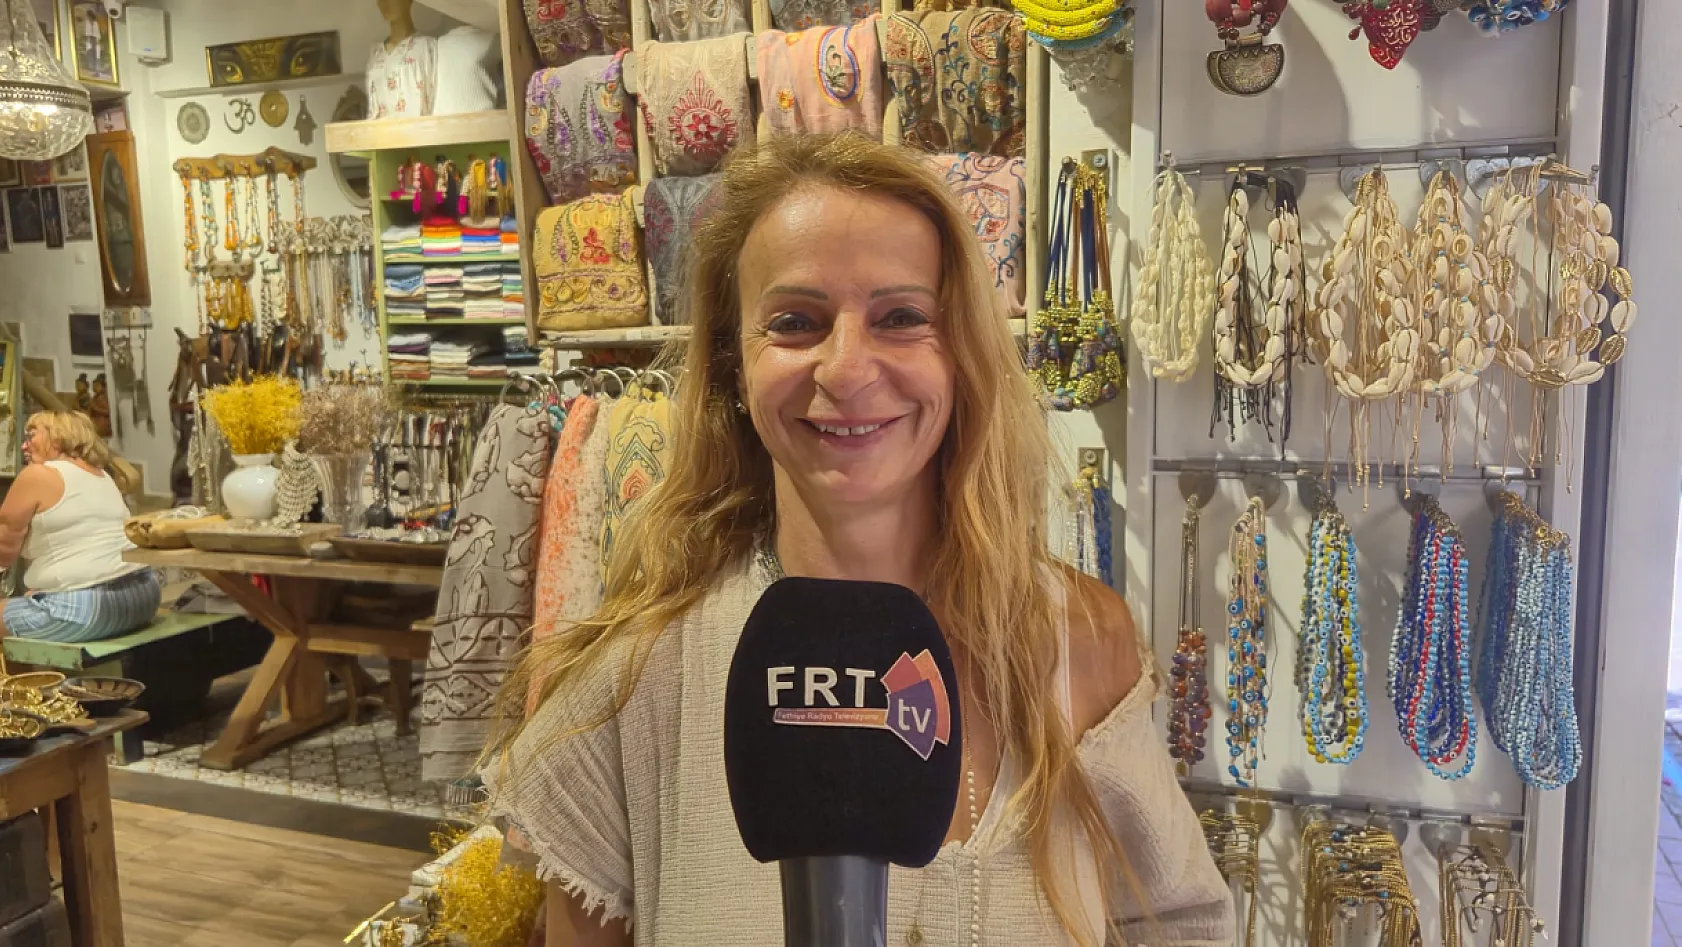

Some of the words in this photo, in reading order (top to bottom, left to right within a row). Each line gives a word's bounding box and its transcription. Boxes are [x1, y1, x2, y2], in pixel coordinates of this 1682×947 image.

[767, 666, 876, 708] FRT
[807, 711, 832, 721] Radyo
[898, 699, 932, 734] tv
